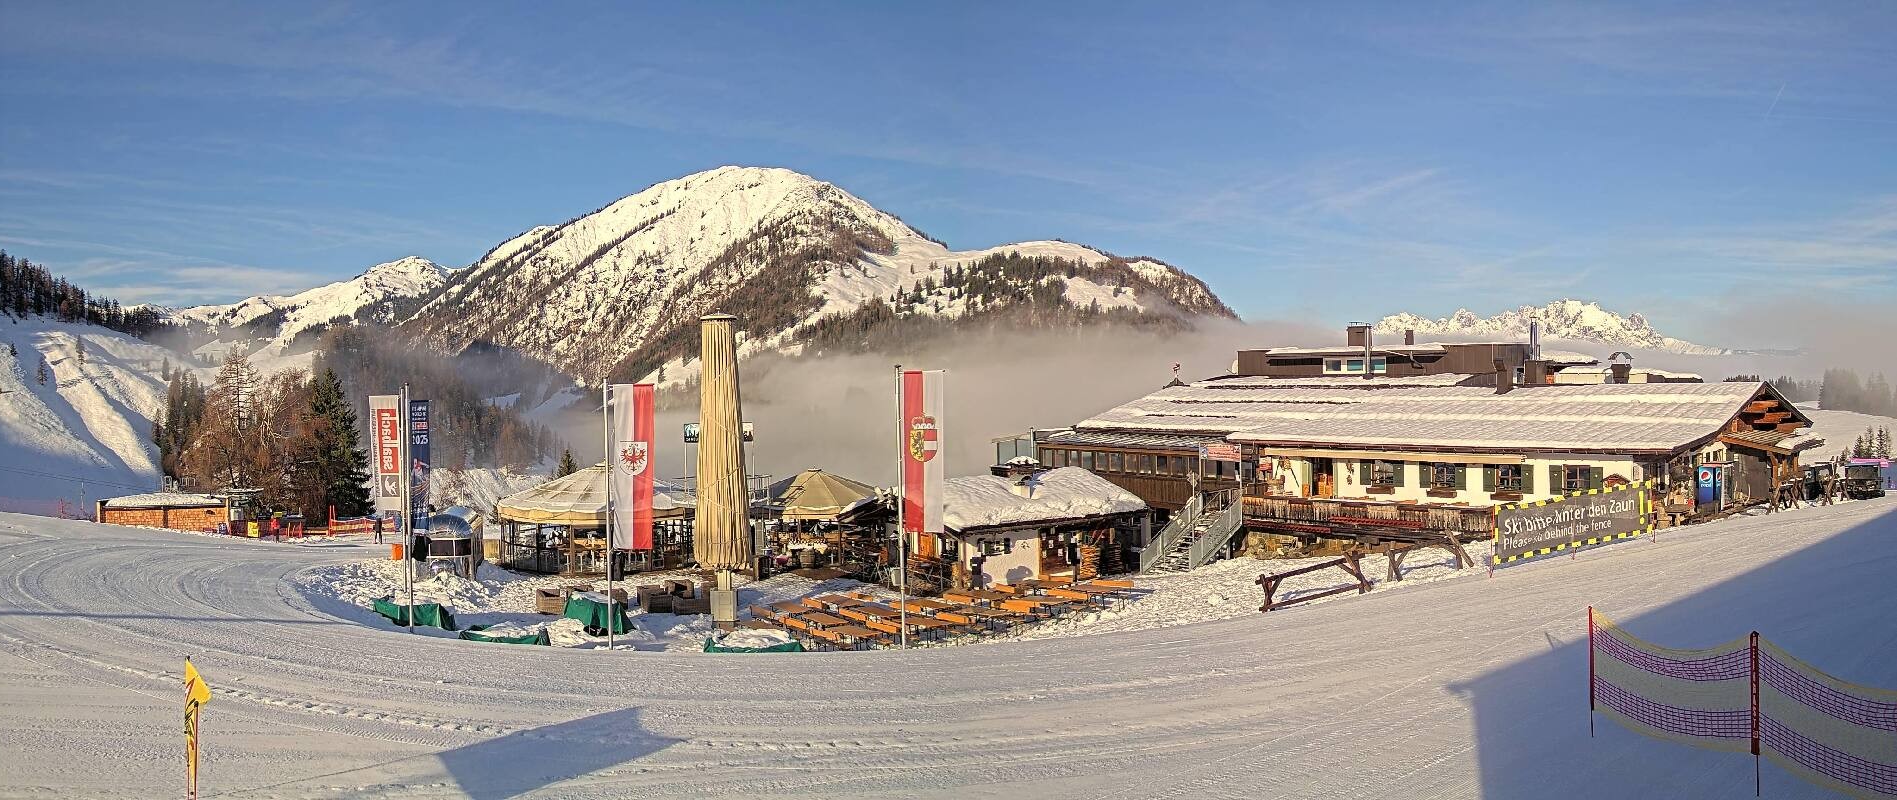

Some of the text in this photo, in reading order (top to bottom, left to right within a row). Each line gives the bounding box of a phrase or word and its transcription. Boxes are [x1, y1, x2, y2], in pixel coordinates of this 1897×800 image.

[1504, 517, 1522, 535] Ski
[1524, 515, 1553, 532] bitte
[1588, 501, 1607, 518] den
[1609, 499, 1635, 514] Zaun
[1503, 536, 1533, 550] Please
[1544, 522, 1573, 540] behind
[1575, 521, 1589, 534] the
[1591, 519, 1611, 532] fence
